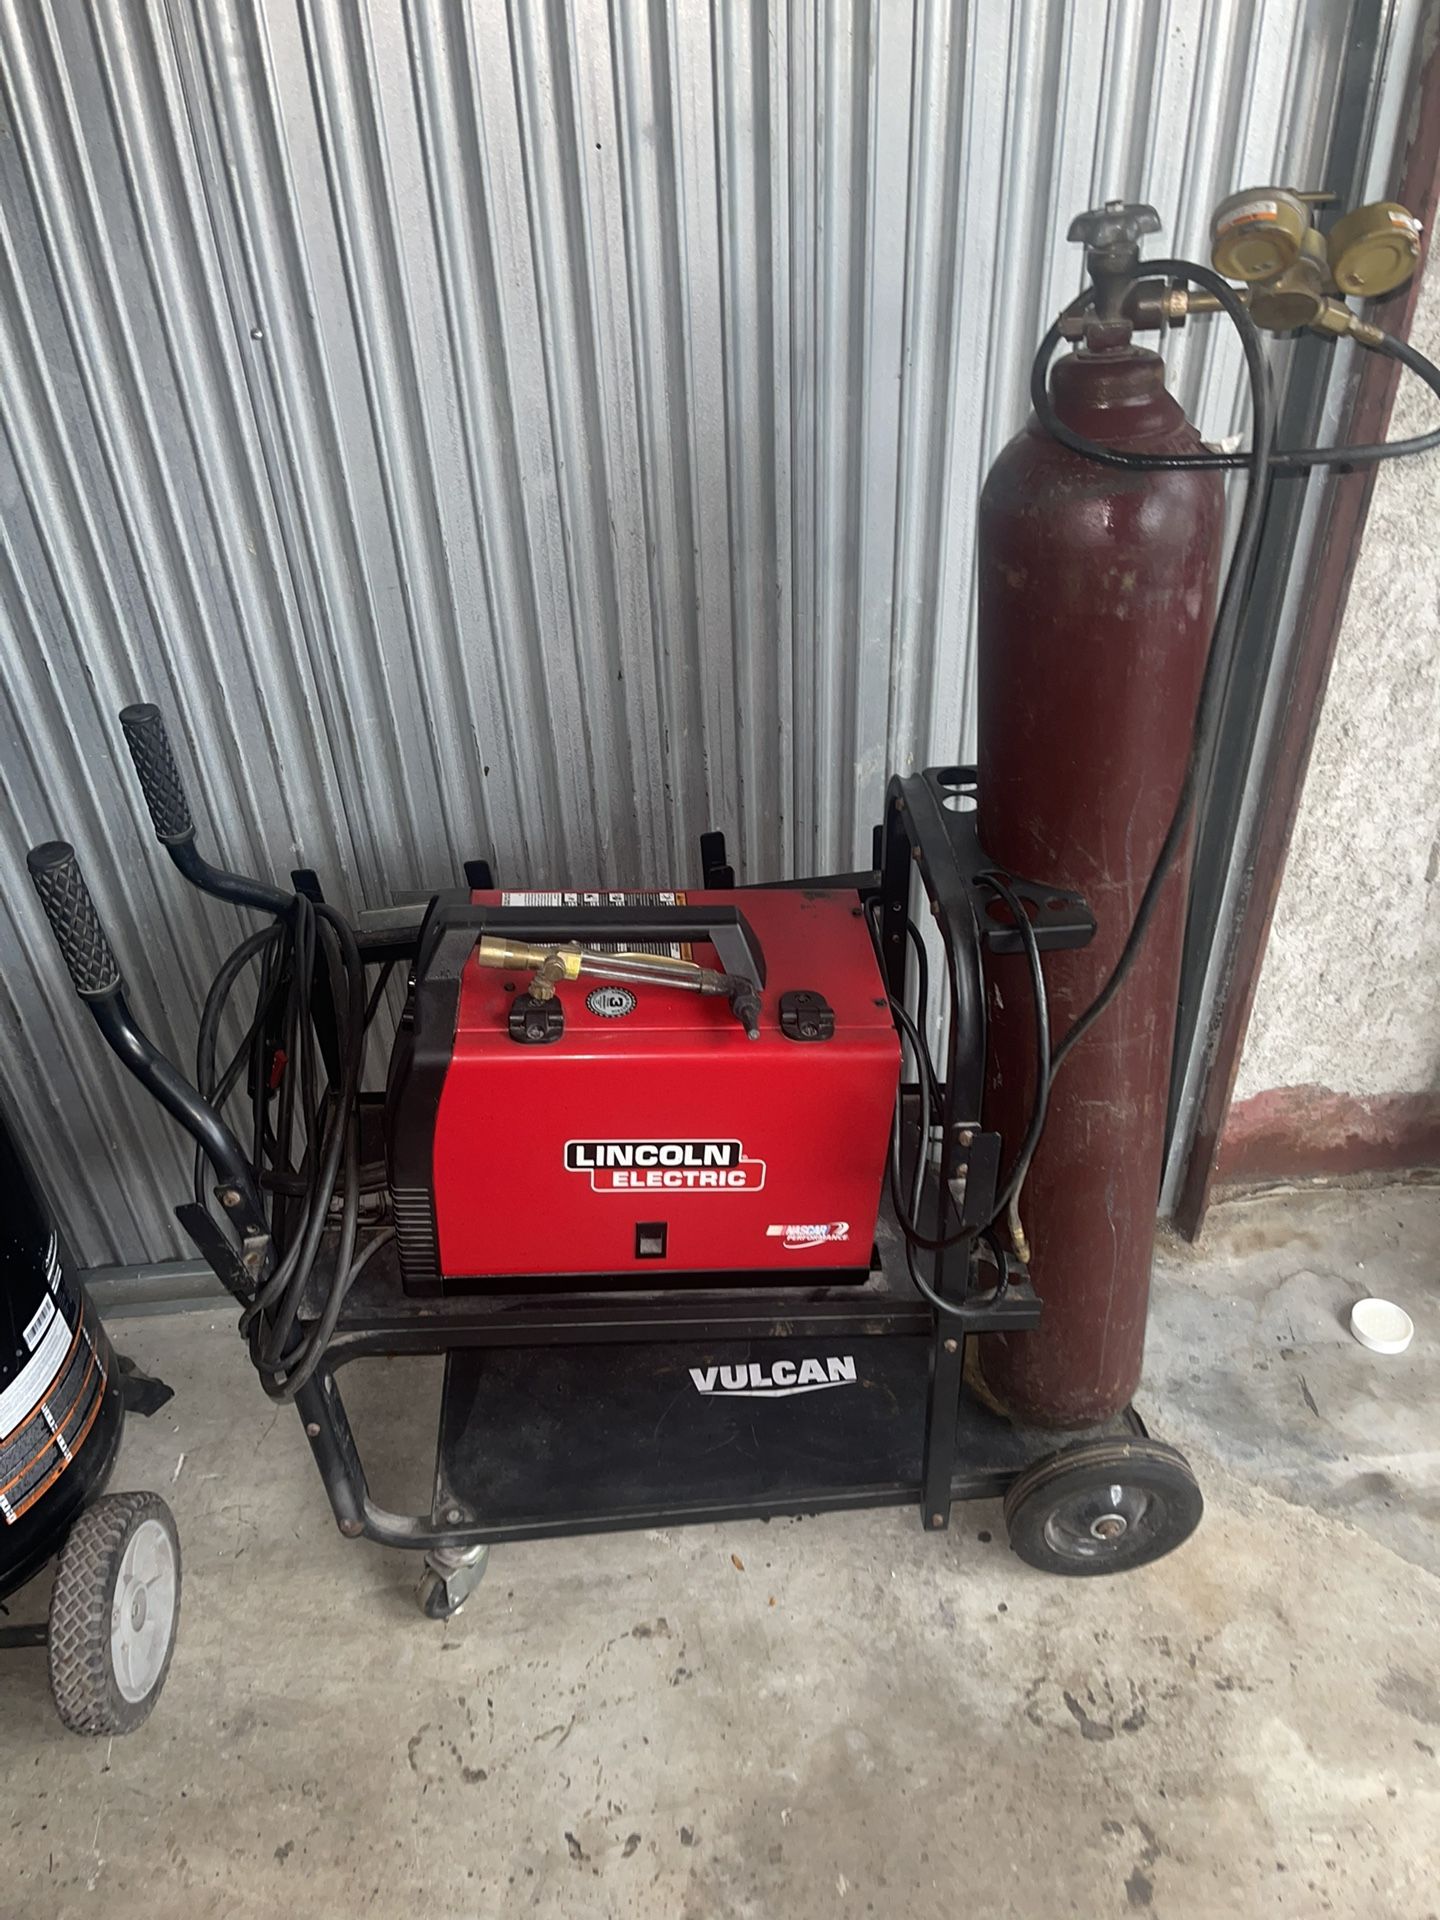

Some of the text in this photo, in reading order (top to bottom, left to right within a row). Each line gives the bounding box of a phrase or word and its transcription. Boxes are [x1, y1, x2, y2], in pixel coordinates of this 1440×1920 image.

[608, 996, 624, 1008] 3
[575, 1144, 732, 1167] LINCOLN
[612, 1170, 748, 1188] ELECTRIC
[786, 1224, 829, 1236] NASCAR
[688, 1356, 858, 1392] VULCAN
